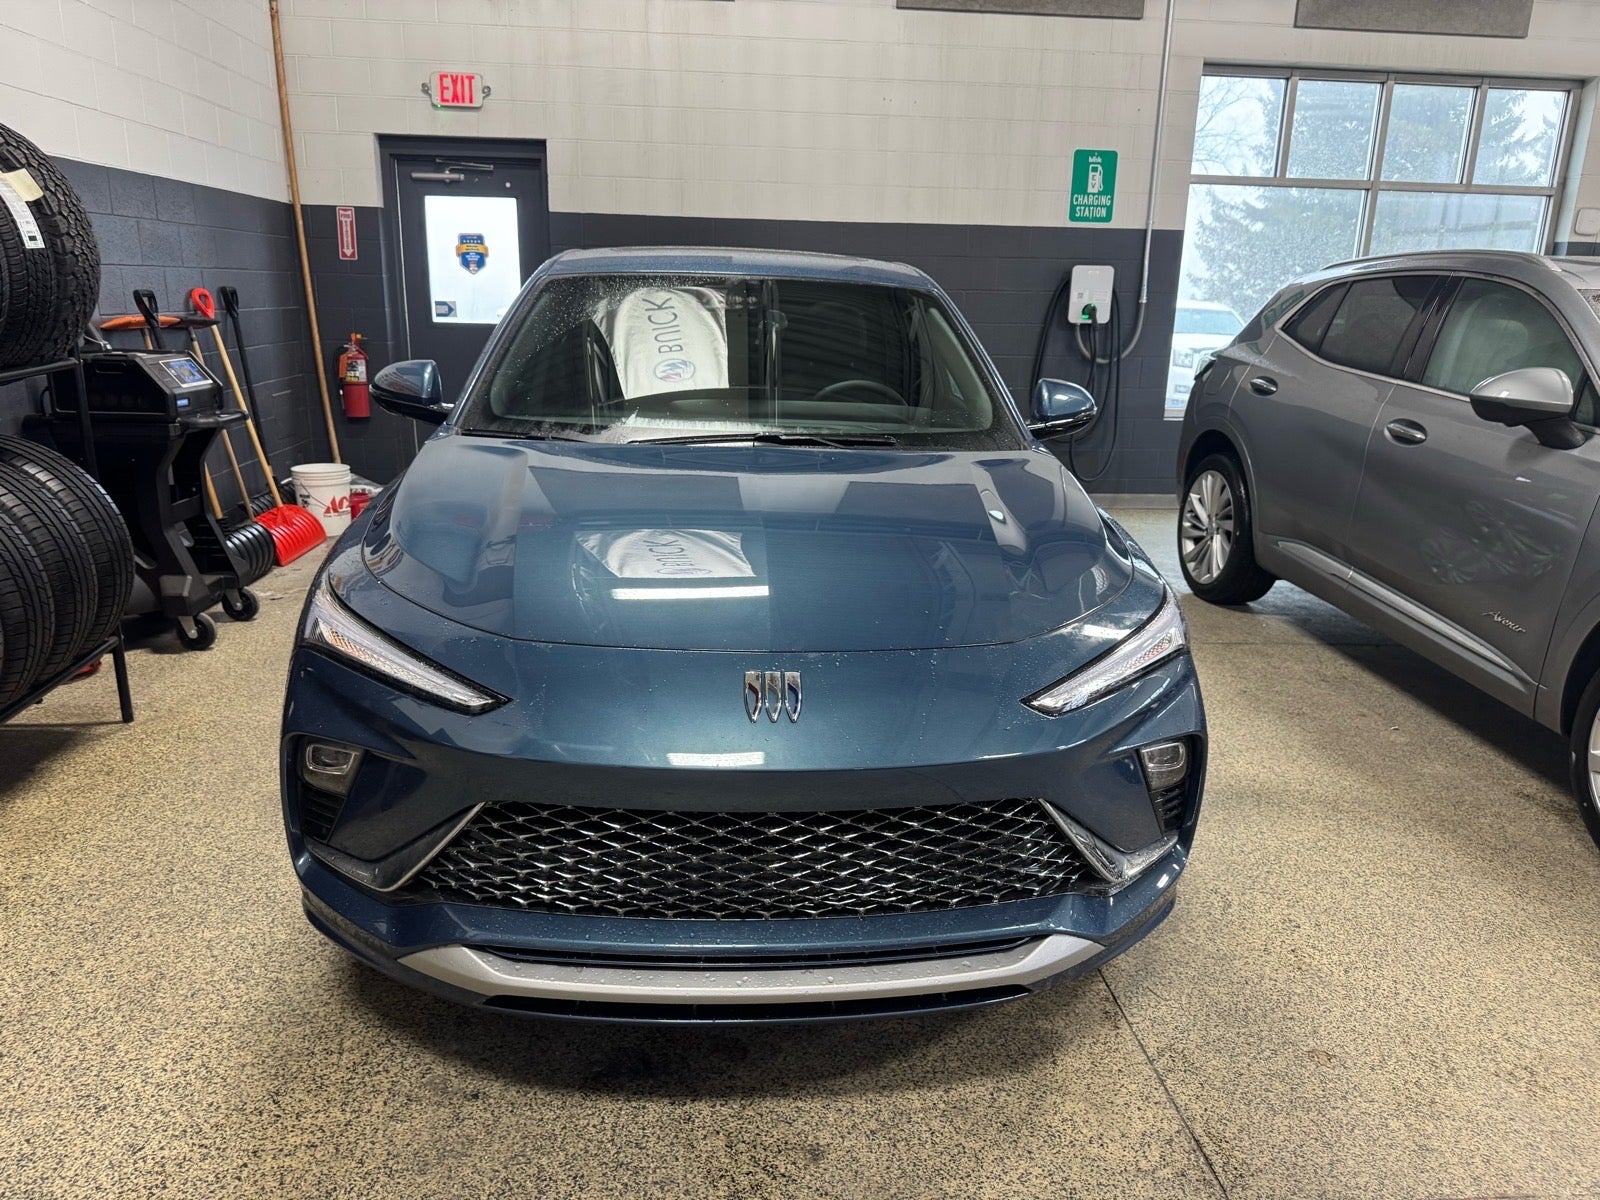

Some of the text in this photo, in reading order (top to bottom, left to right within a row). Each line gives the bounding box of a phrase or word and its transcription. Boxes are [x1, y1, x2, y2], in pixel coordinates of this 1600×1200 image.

[439, 73, 475, 104] EXIT
[1091, 174, 1097, 189] EV
[1073, 194, 1111, 206] CHARGING
[1075, 206, 1107, 217] STATION
